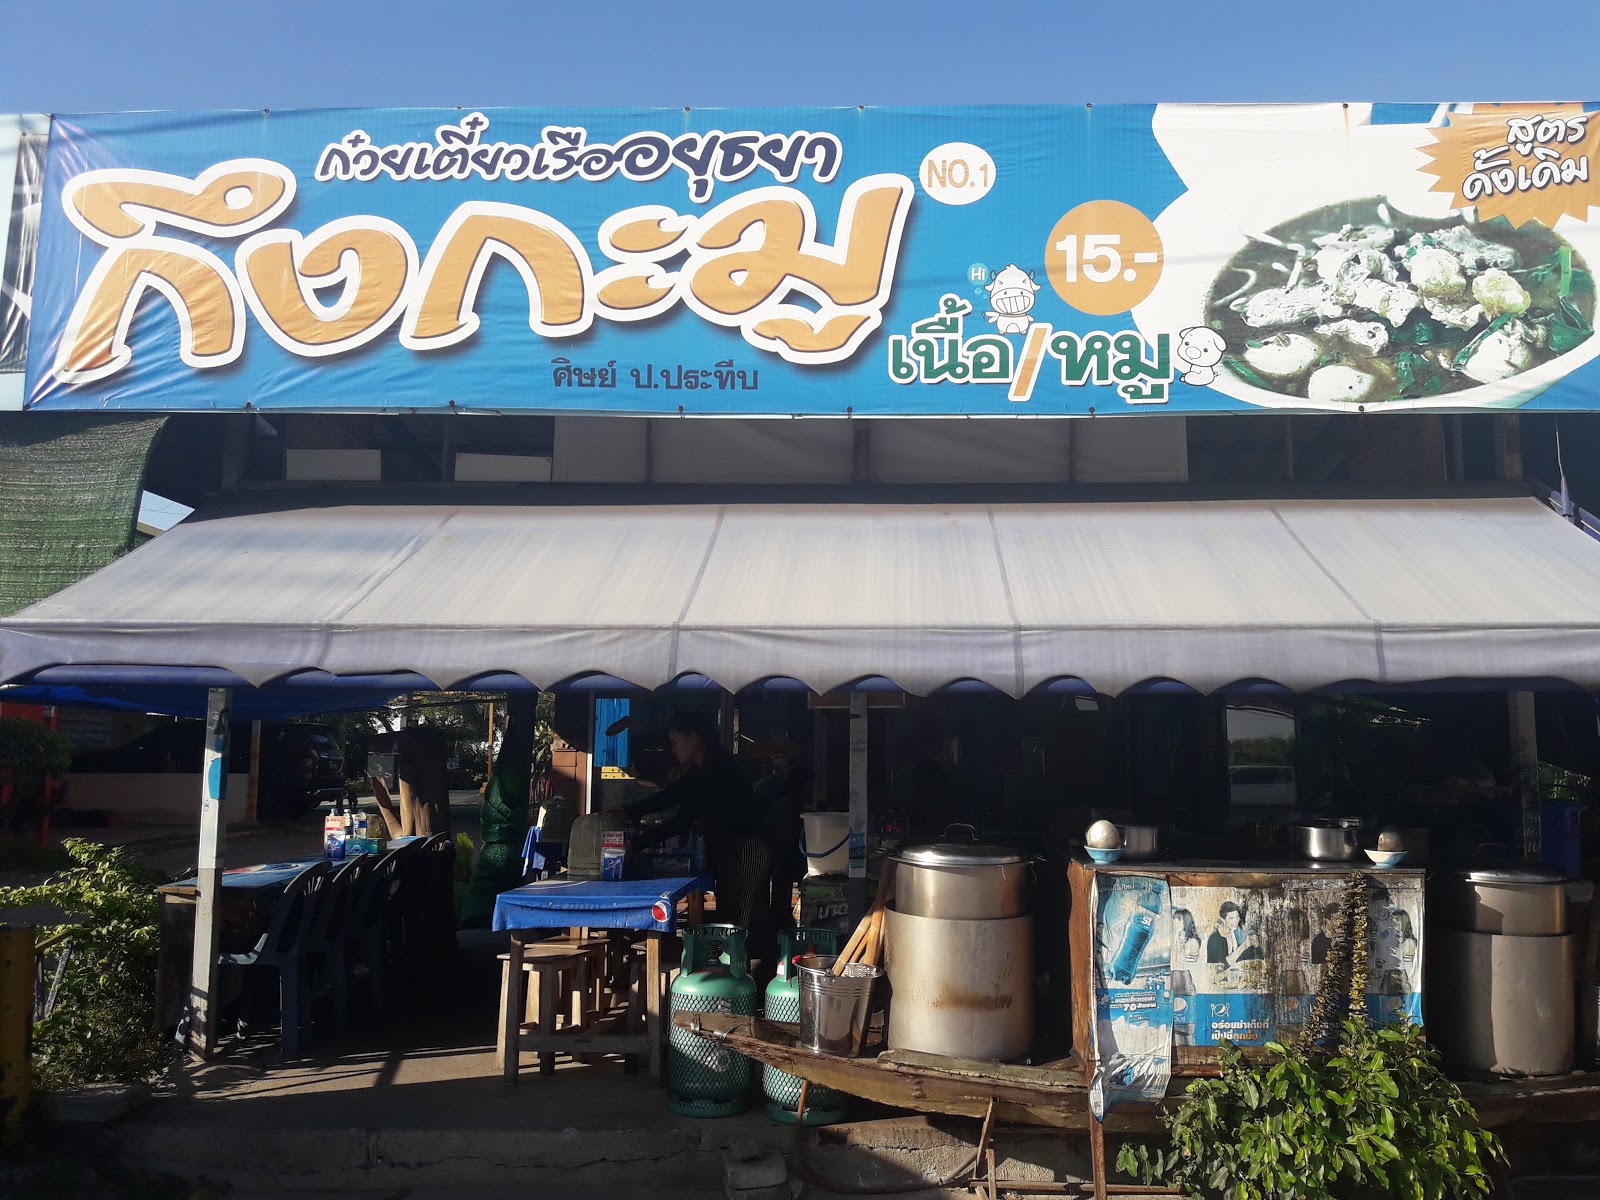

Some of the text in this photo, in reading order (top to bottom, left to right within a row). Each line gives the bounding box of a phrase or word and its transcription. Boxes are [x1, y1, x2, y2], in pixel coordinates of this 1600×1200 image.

[1506, 114, 1588, 156] สูตร
[317, 114, 841, 200] ก๋วยเตี๋ยวเรืออยุธยา
[927, 158, 989, 188] NO.1
[1462, 145, 1589, 201] ดั้งเดิม
[970, 266, 986, 281] Hi
[1056, 233, 1158, 283] 15.-
[551, 357, 617, 388] ศิษย์
